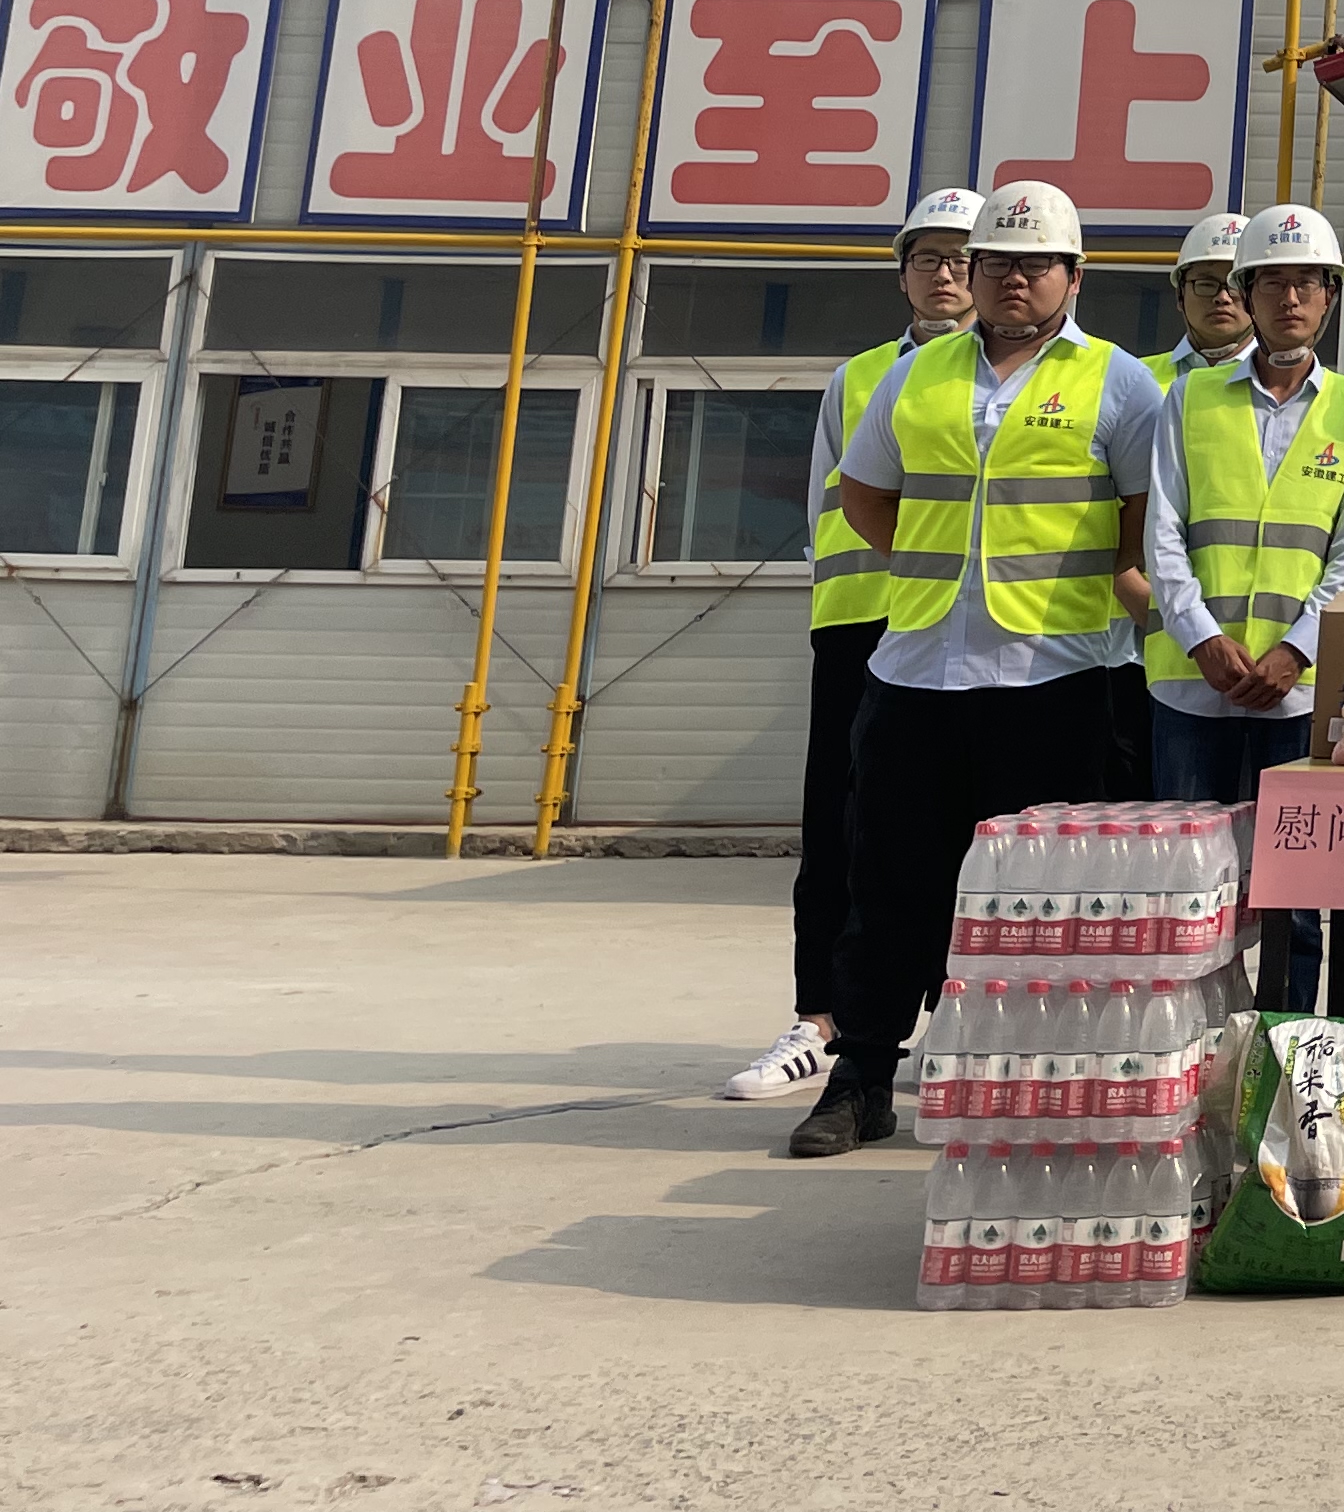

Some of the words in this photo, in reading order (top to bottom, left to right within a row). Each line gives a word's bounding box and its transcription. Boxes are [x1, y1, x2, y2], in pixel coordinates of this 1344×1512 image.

[927, 203, 970, 217] 安徽建工
[1024, 415, 1075, 431] 安徽建工
